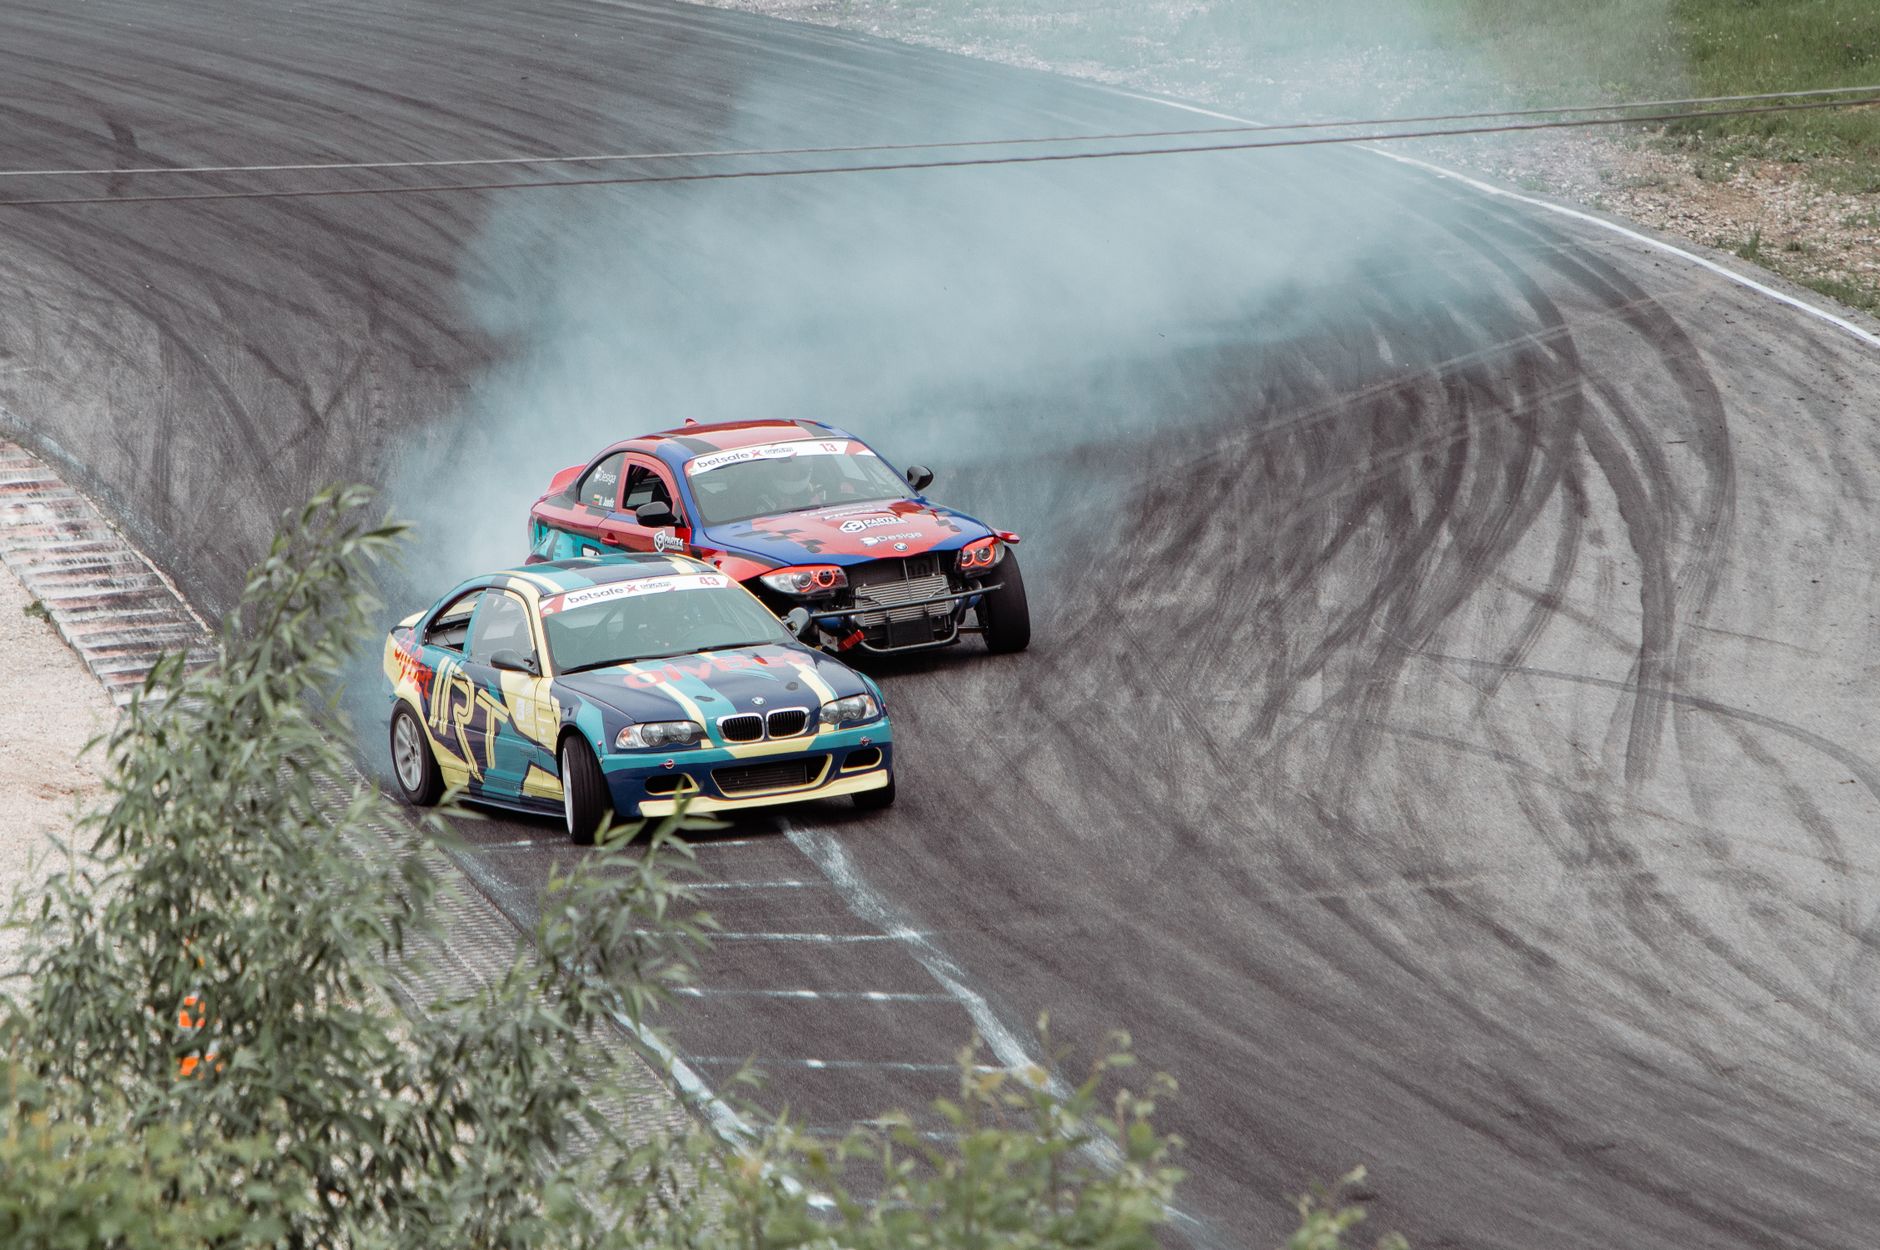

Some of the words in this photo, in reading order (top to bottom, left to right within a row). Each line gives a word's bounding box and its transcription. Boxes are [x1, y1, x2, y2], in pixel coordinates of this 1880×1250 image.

[820, 443, 837, 452] 13
[697, 453, 749, 468] betsafe
[699, 576, 720, 585] 43
[568, 589, 624, 603] betsafe
